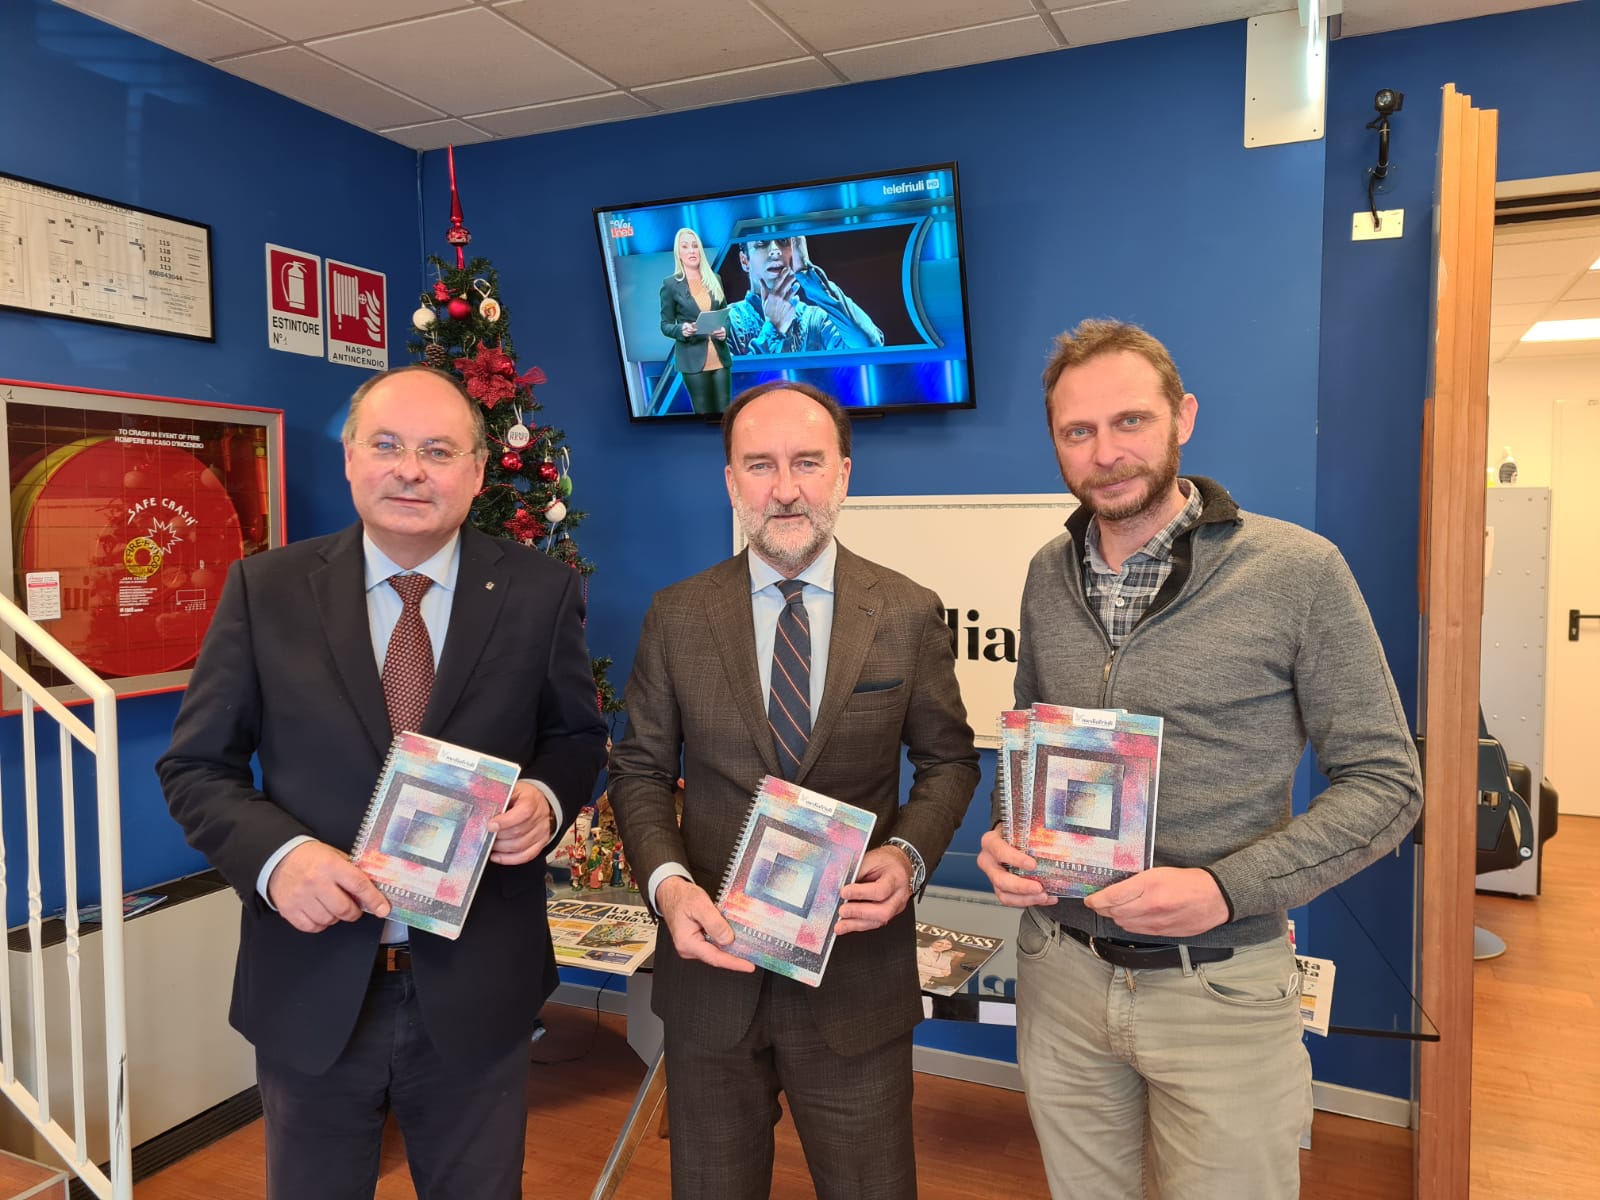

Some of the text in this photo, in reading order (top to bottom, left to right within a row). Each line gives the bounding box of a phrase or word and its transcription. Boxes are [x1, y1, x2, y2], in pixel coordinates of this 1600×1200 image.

[883, 180, 924, 195] telefriuli
[159, 255, 171, 263] 112
[272, 315, 320, 336] ESTINTORE
[345, 344, 372, 357] NASPO
[332, 352, 385, 369] ANTINCENDIO
[128, 429, 150, 437] CRASH
[158, 431, 178, 440] EVENT
[178, 433, 187, 441] OF
[187, 434, 200, 442] FIRE
[153, 439, 171, 447] CASO
[127, 497, 196, 527] SAFE CRASH
[612, 906, 629, 915] La
[606, 913, 639, 923] della
[915, 922, 996, 949] BUSINESS
